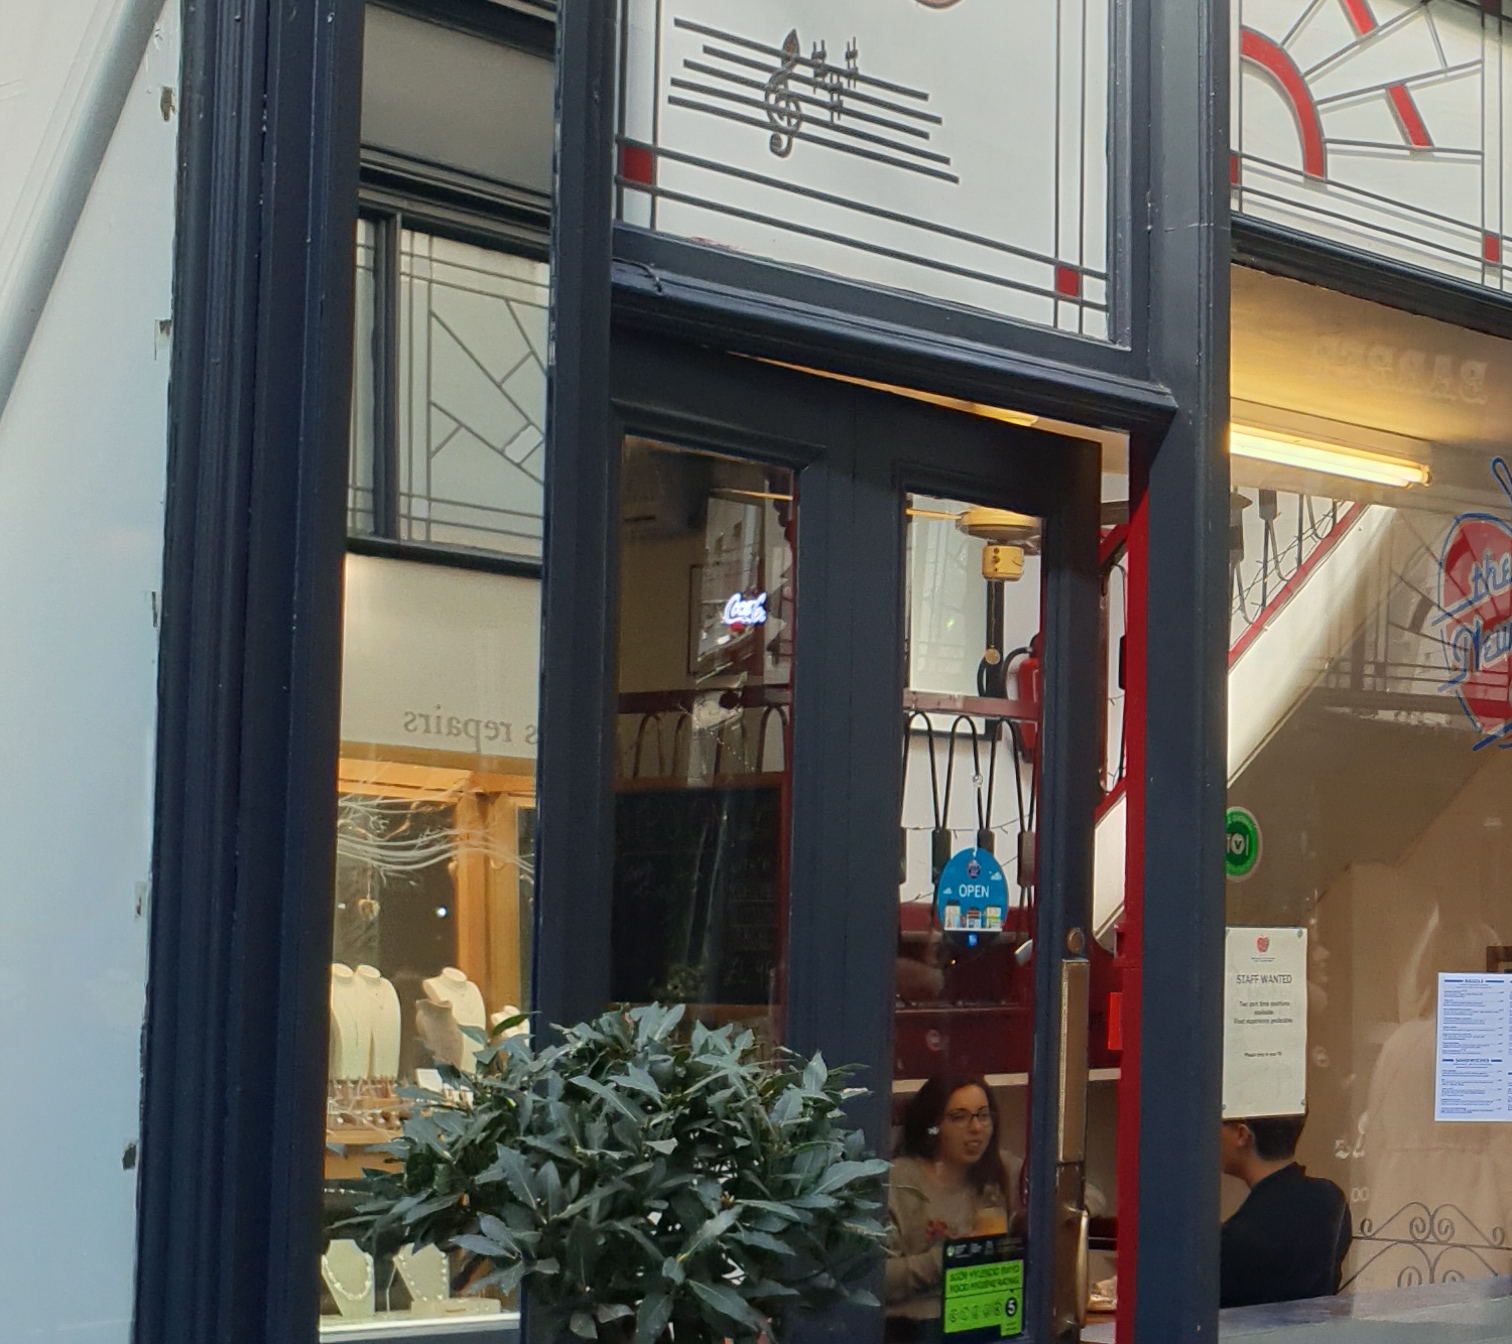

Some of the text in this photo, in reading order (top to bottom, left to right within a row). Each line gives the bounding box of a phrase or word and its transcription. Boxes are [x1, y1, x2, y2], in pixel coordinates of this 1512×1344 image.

[958, 883, 990, 898] OPEN
[1236, 974, 1292, 984] STAFF WANTED
[1007, 1299, 1016, 1314] 5
